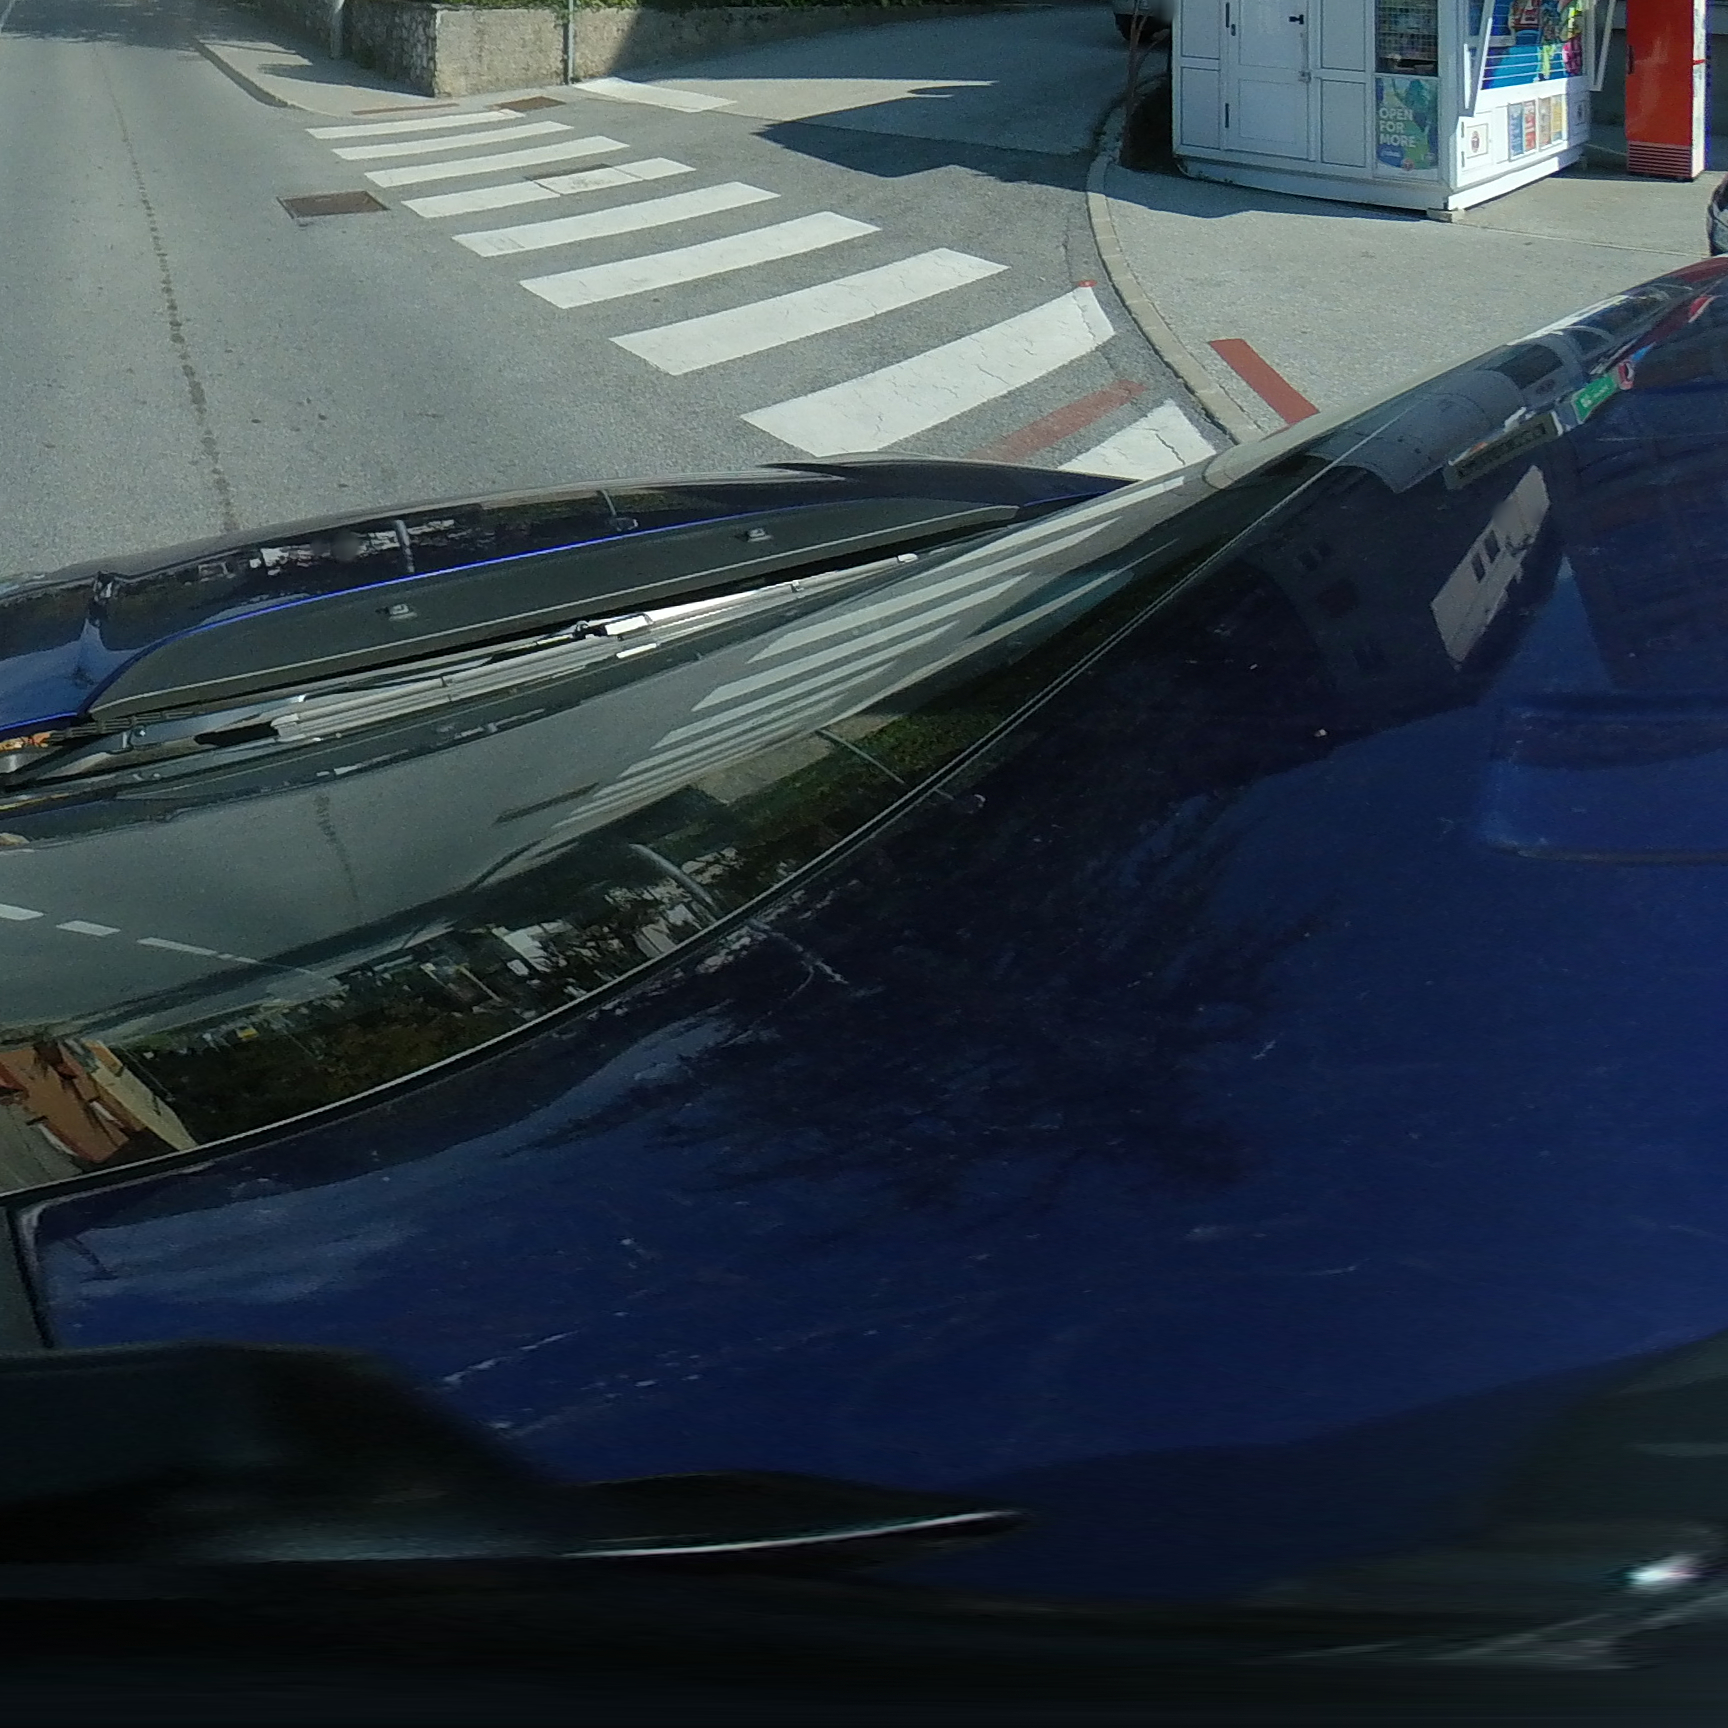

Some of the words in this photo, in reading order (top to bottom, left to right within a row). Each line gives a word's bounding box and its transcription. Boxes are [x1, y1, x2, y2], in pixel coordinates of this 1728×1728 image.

[1379, 107, 1413, 121] OPEN
[1379, 120, 1404, 134] FOR
[1379, 133, 1416, 148] MORE
